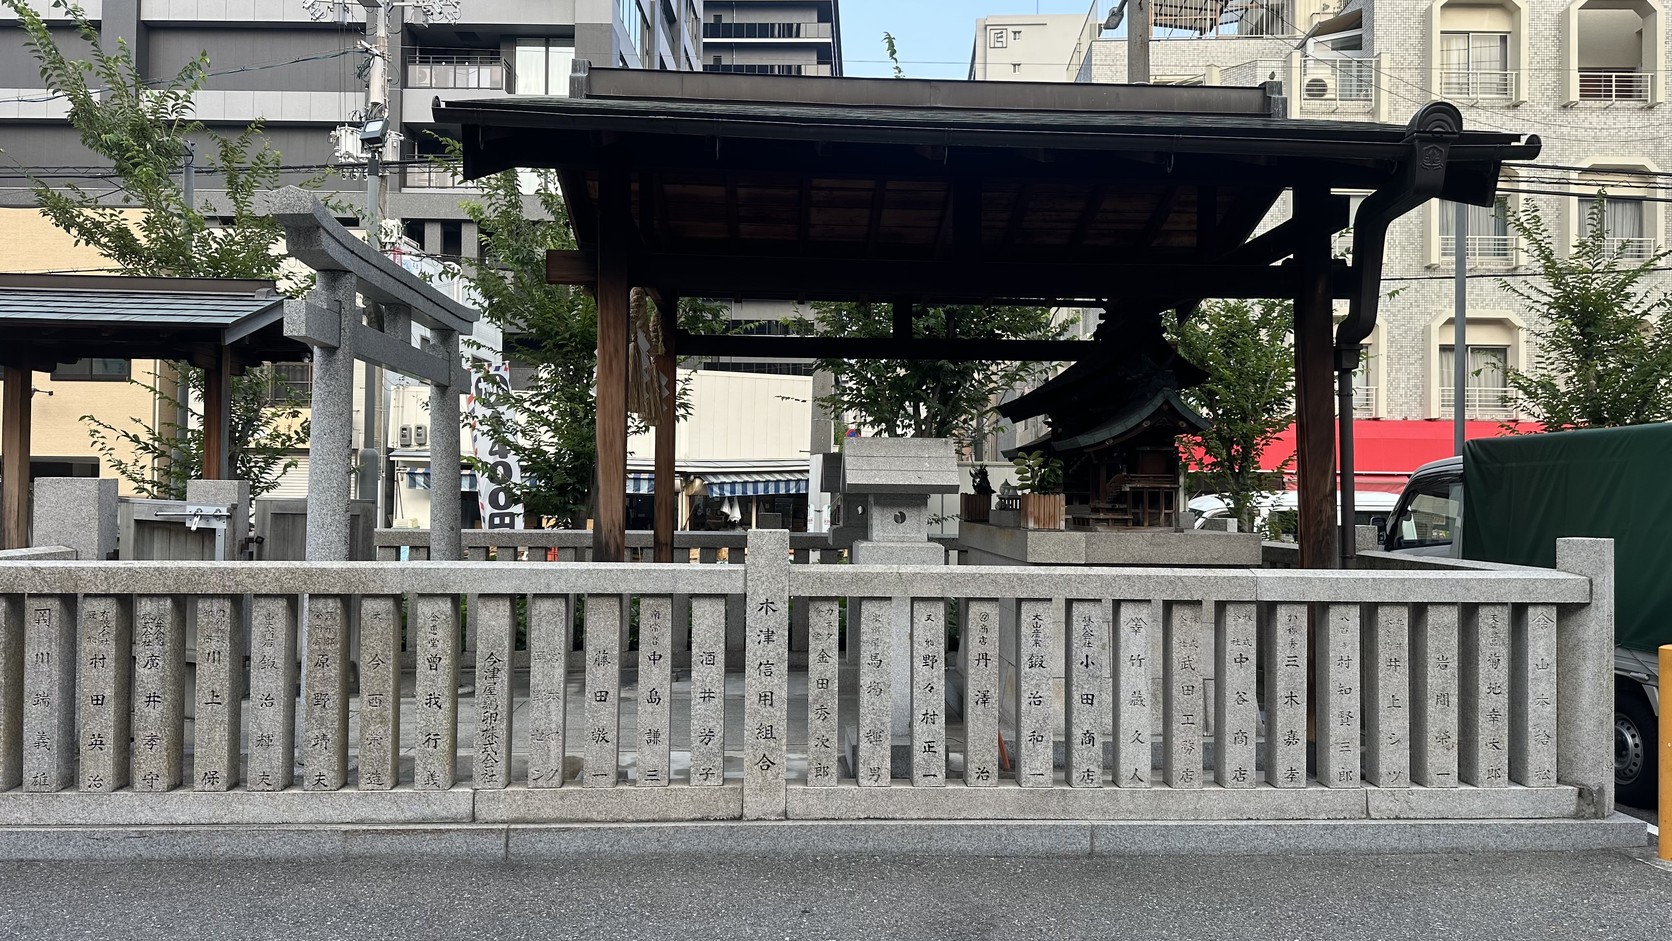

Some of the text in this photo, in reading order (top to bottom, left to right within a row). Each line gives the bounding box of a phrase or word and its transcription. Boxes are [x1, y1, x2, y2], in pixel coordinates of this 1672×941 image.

[87, 653, 107, 788] 村田英治
[201, 650, 222, 786] 川上保
[591, 650, 611, 778] 藤田敬一
[645, 651, 663, 781] 中島謙三
[698, 651, 716, 781] 酒井芳子
[755, 599, 777, 771] 木津信用組合
[814, 649, 831, 778] 金田秀次郎
[921, 655, 938, 778] 野々村正一
[1079, 615, 1095, 783] 株式会社 小田商店
[1180, 656, 1196, 783] 武田工務店
[1232, 653, 1249, 782] 中谷商店
[1284, 655, 1300, 783] 三木嘉孝
[1387, 658, 1401, 783] 井上シツ
